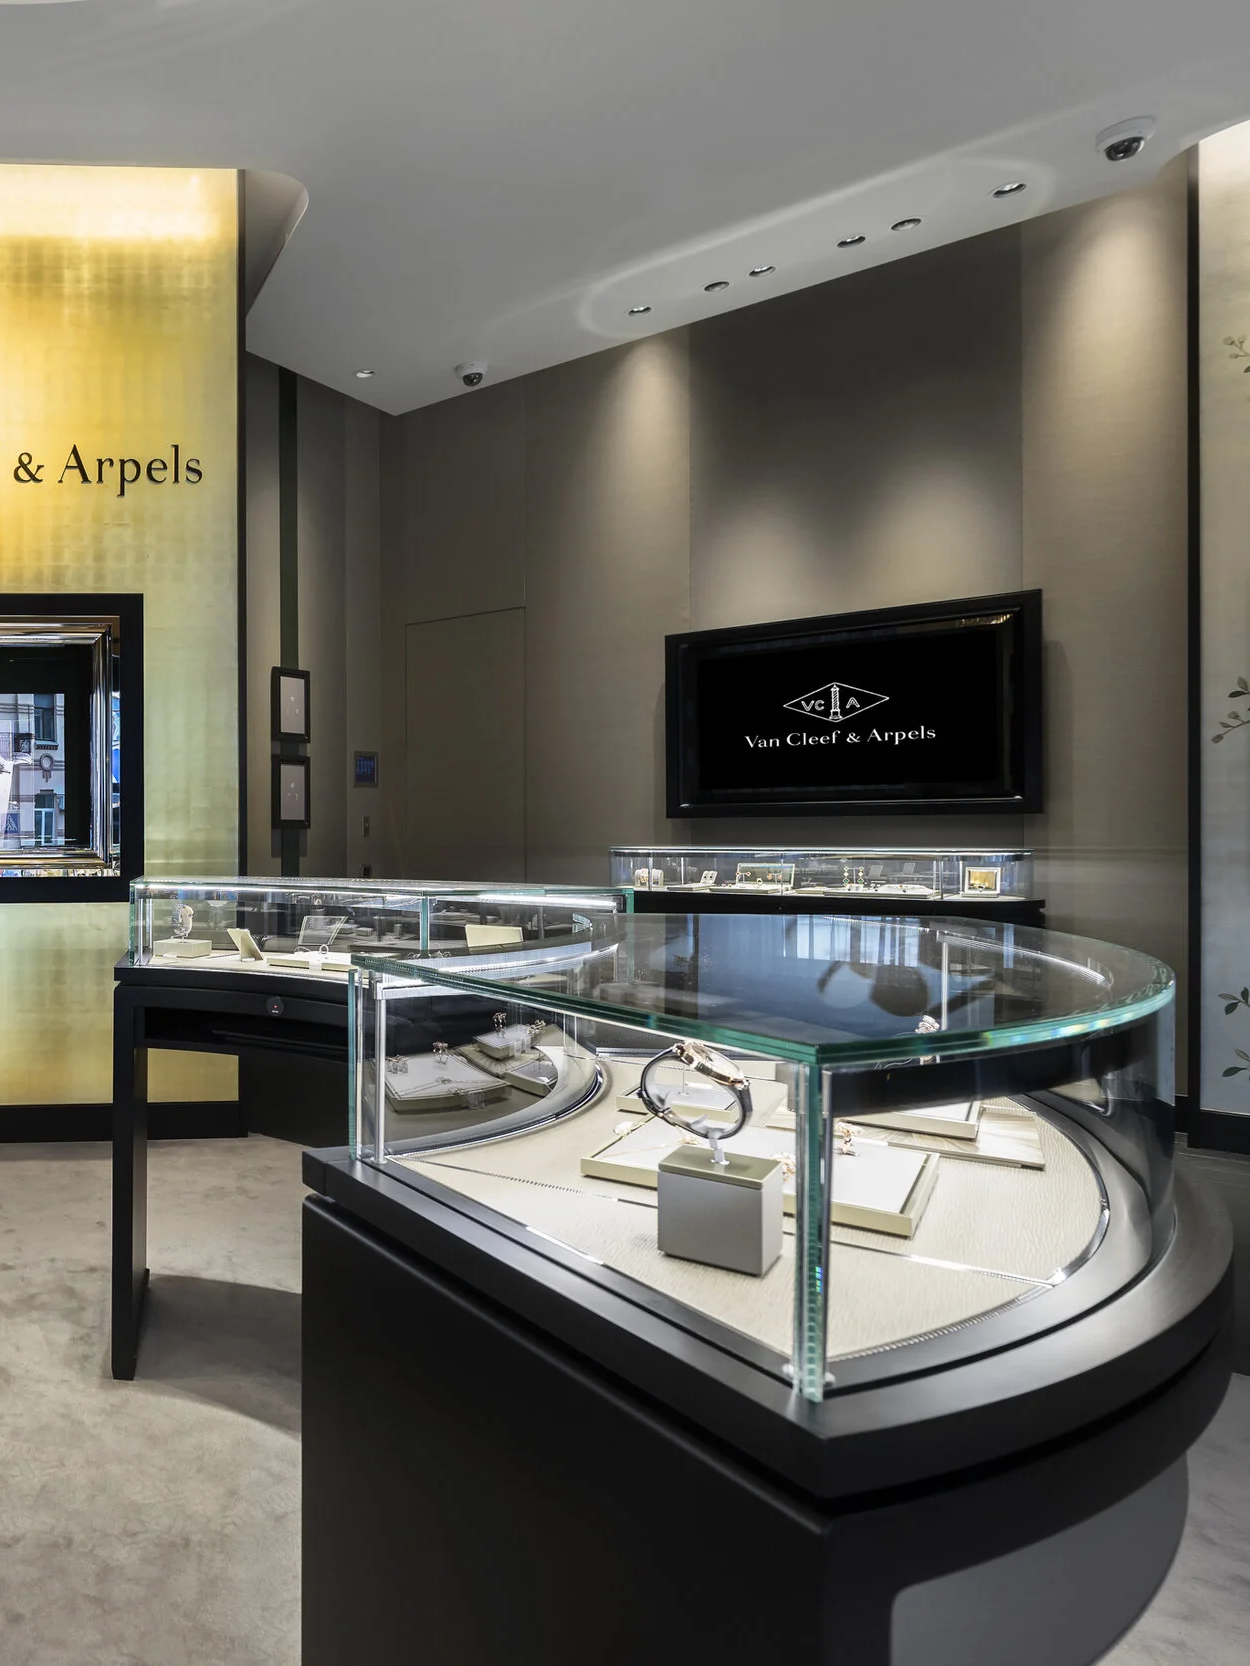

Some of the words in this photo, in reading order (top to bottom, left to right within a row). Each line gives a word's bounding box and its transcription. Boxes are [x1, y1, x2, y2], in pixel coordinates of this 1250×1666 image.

[13, 452, 45, 484] &
[57, 444, 204, 497] Arpels
[744, 735, 780, 748] Van
[786, 730, 841, 746] Cleef
[846, 732, 861, 743] &
[867, 725, 937, 746] Arpels
